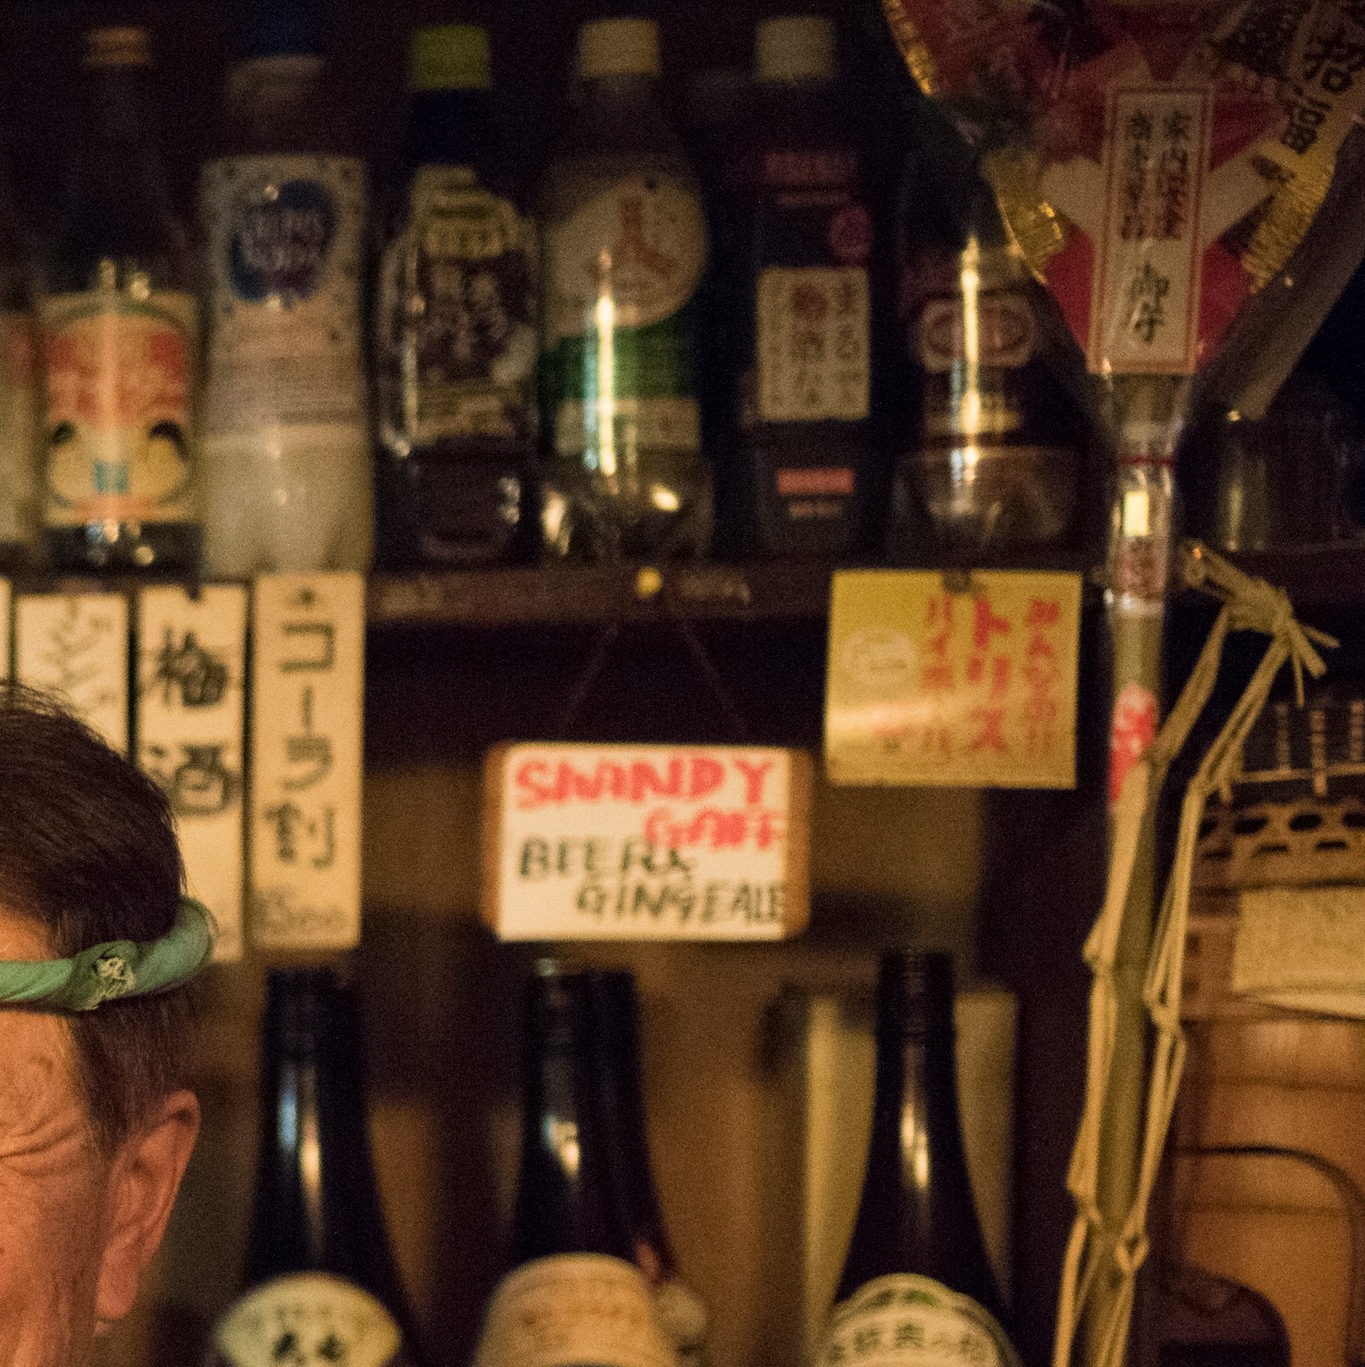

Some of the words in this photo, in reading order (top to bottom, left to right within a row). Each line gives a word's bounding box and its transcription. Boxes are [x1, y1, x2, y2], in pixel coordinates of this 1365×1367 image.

[139, 622, 233, 820] 梅酒
[260, 619, 338, 869] コーラ割
[965, 595, 1011, 758] トリス
[513, 755, 776, 812] SHANDY
